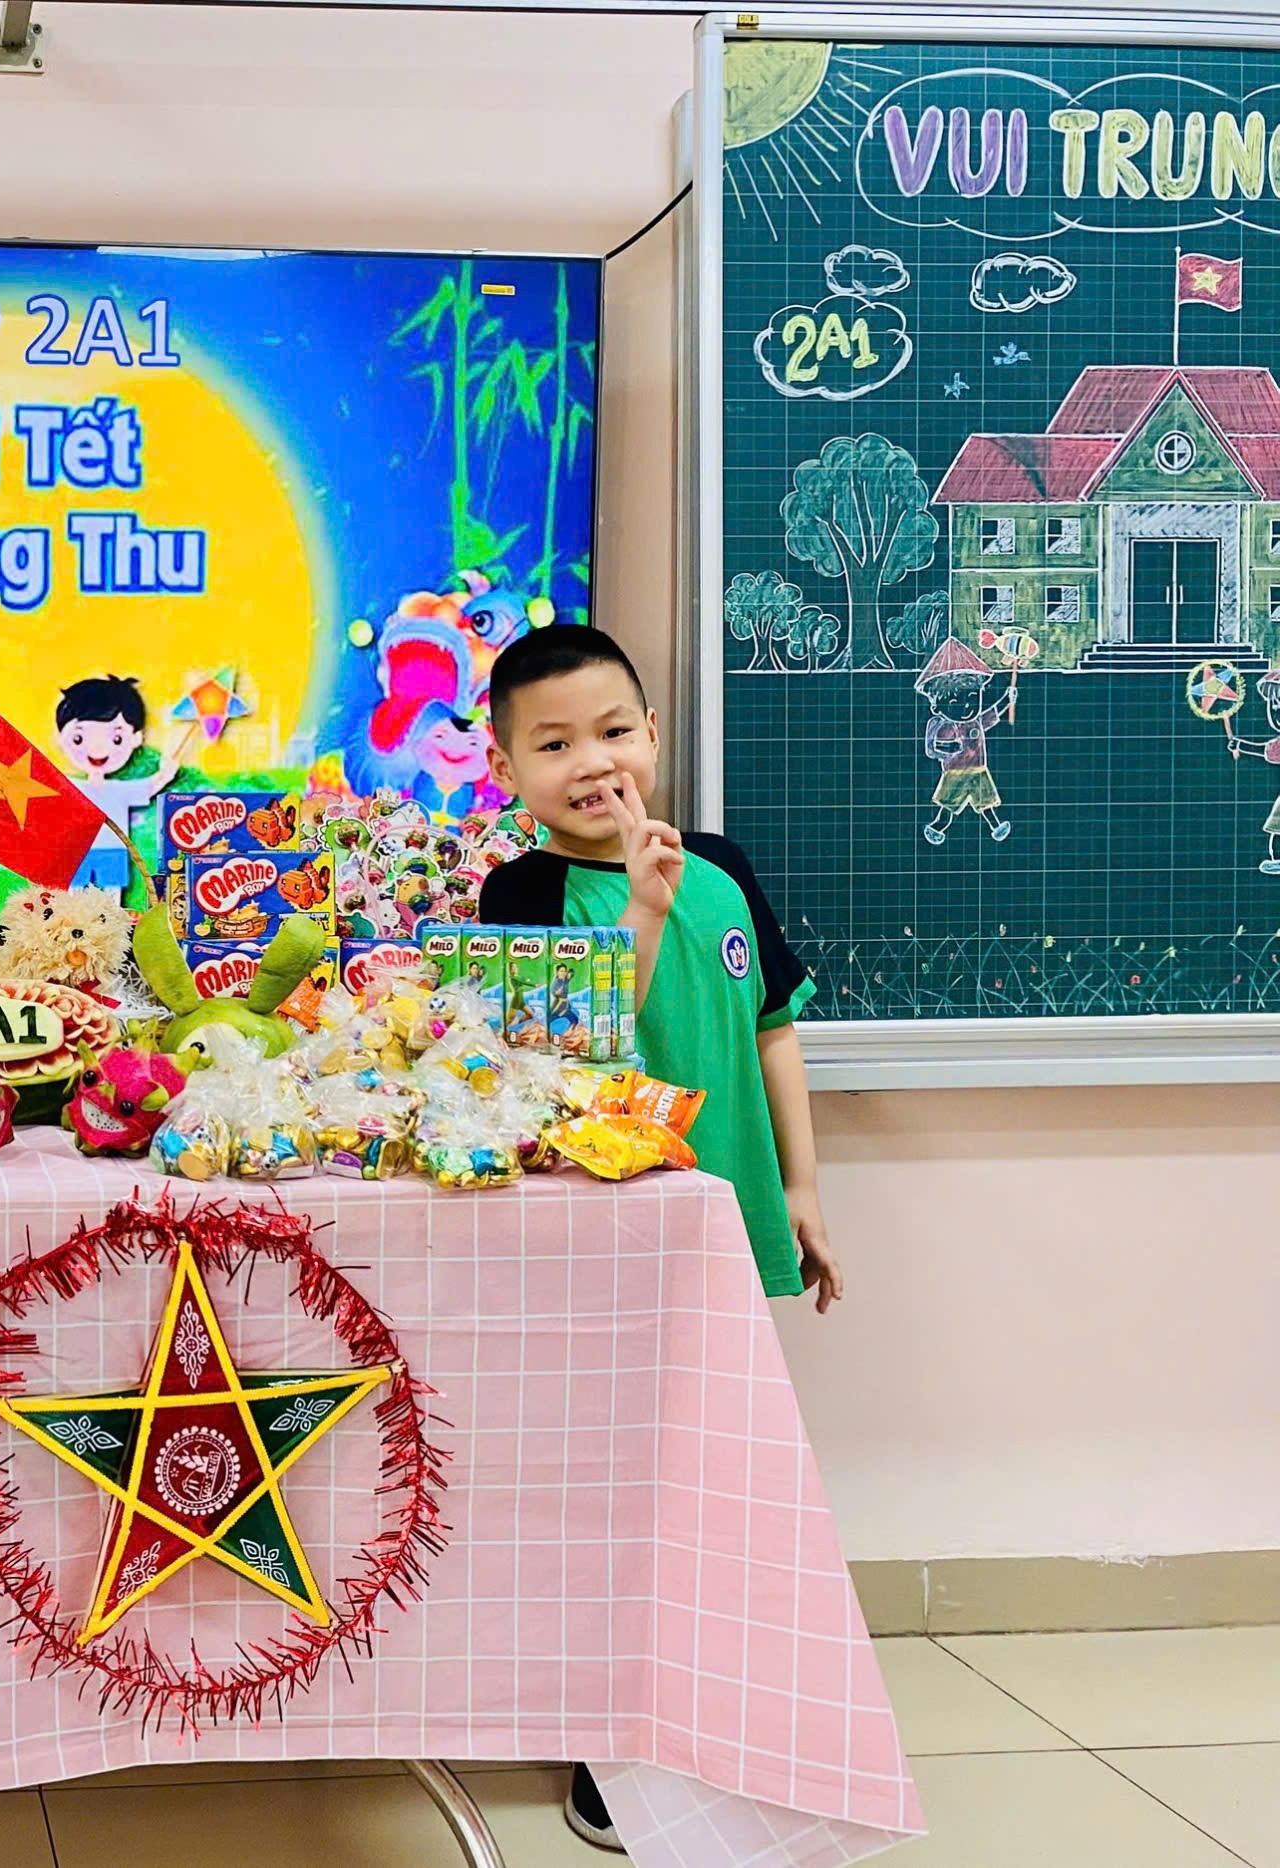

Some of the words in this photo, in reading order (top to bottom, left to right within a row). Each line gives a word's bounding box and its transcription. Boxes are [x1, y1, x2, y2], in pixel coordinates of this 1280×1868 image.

[884, 106, 1028, 198] VUI
[1049, 109, 1280, 201] TRUN
[24, 293, 181, 366] 2A1
[781, 313, 879, 383] 2A1
[15, 397, 142, 487] Tết
[68, 513, 206, 592] Thu
[214, 819, 235, 833] BOY
[243, 881, 265, 897] BOY
[429, 942, 453, 951] MILO
[470, 942, 497, 952] MILO
[513, 943, 539, 953] MILO
[558, 944, 585, 954] MILO
[195, 960, 260, 999] MARI
